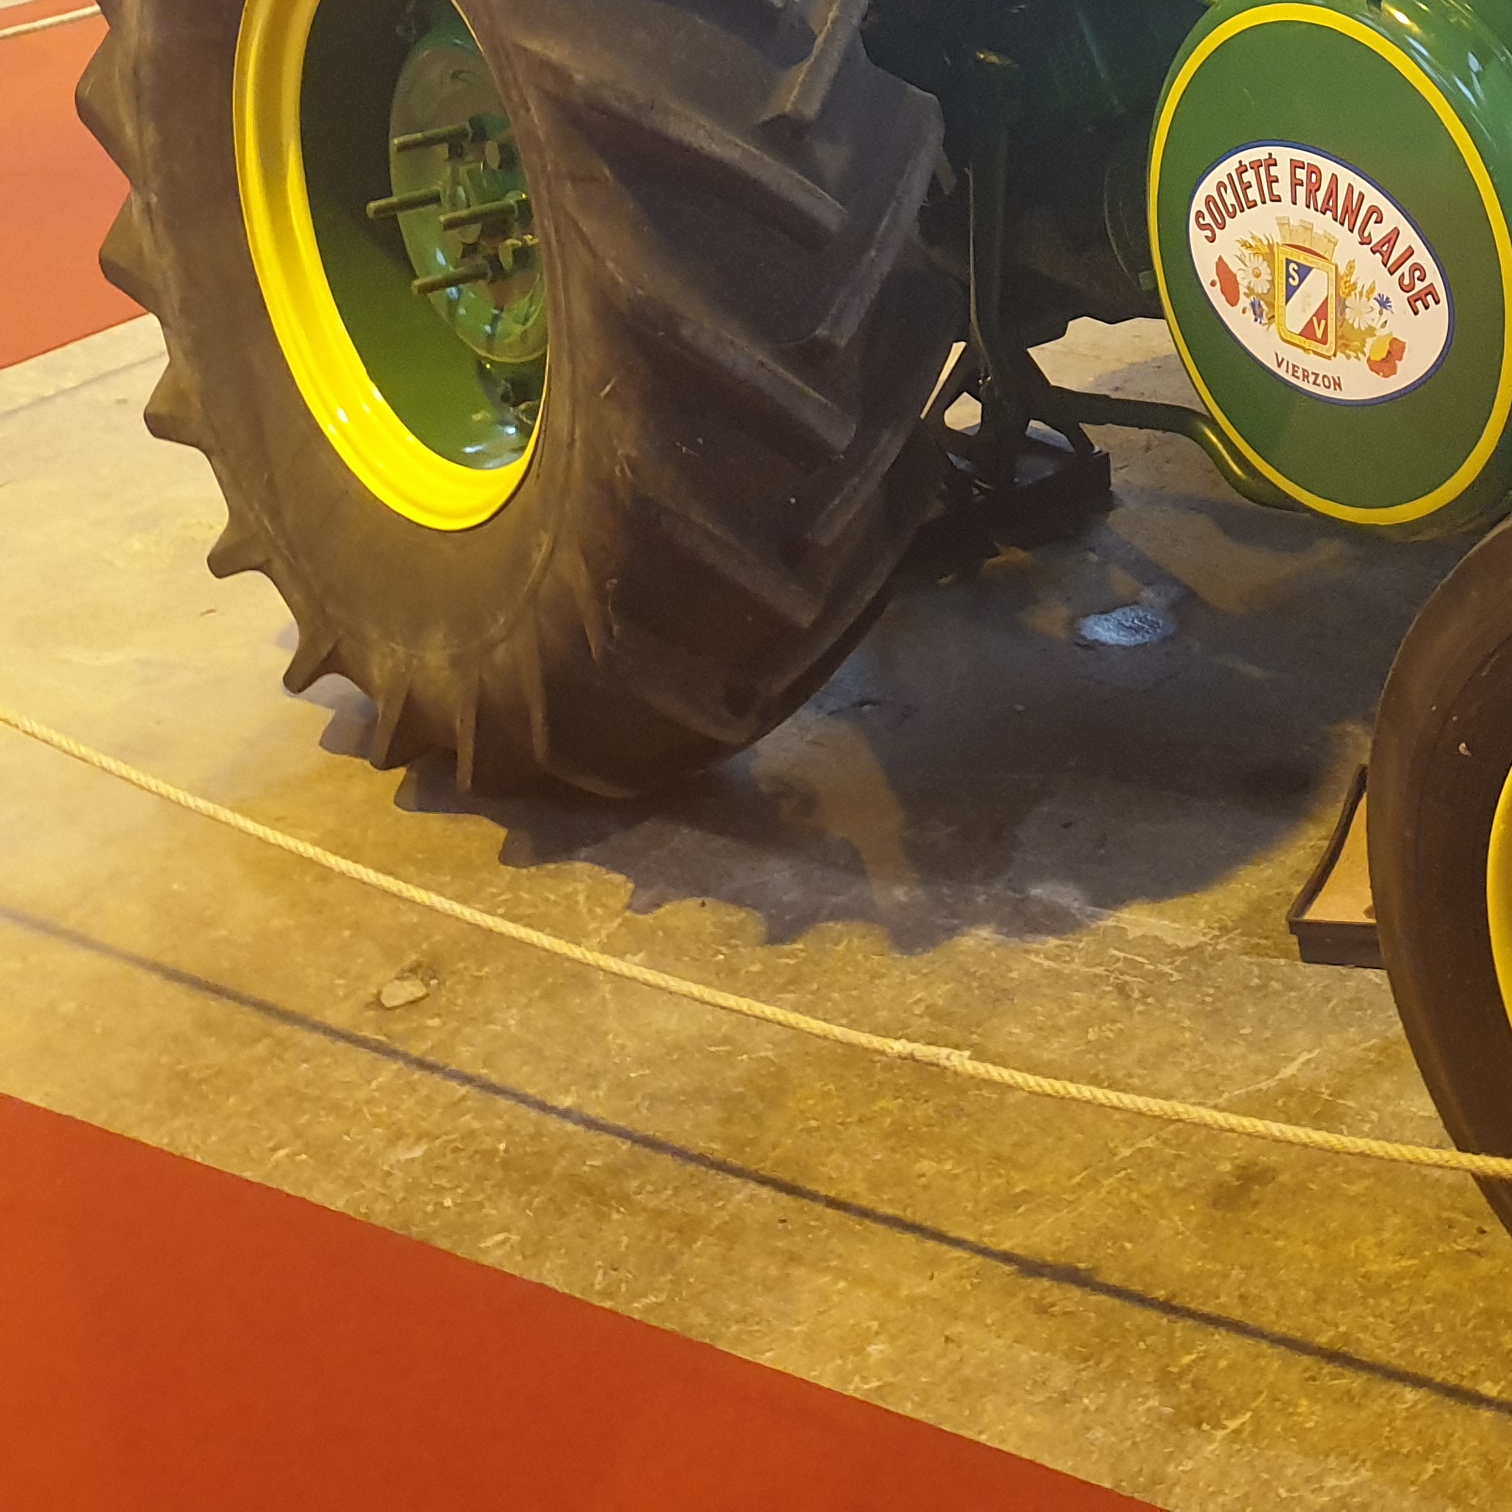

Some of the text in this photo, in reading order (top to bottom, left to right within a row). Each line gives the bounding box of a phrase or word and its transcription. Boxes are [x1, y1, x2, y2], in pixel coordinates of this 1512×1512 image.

[1194, 152, 1441, 317] SOCIÉTÉ FRANÇAISE
[1288, 262, 1299, 287] S
[1312, 316, 1326, 340] V
[1274, 351, 1343, 392] VIERZON
